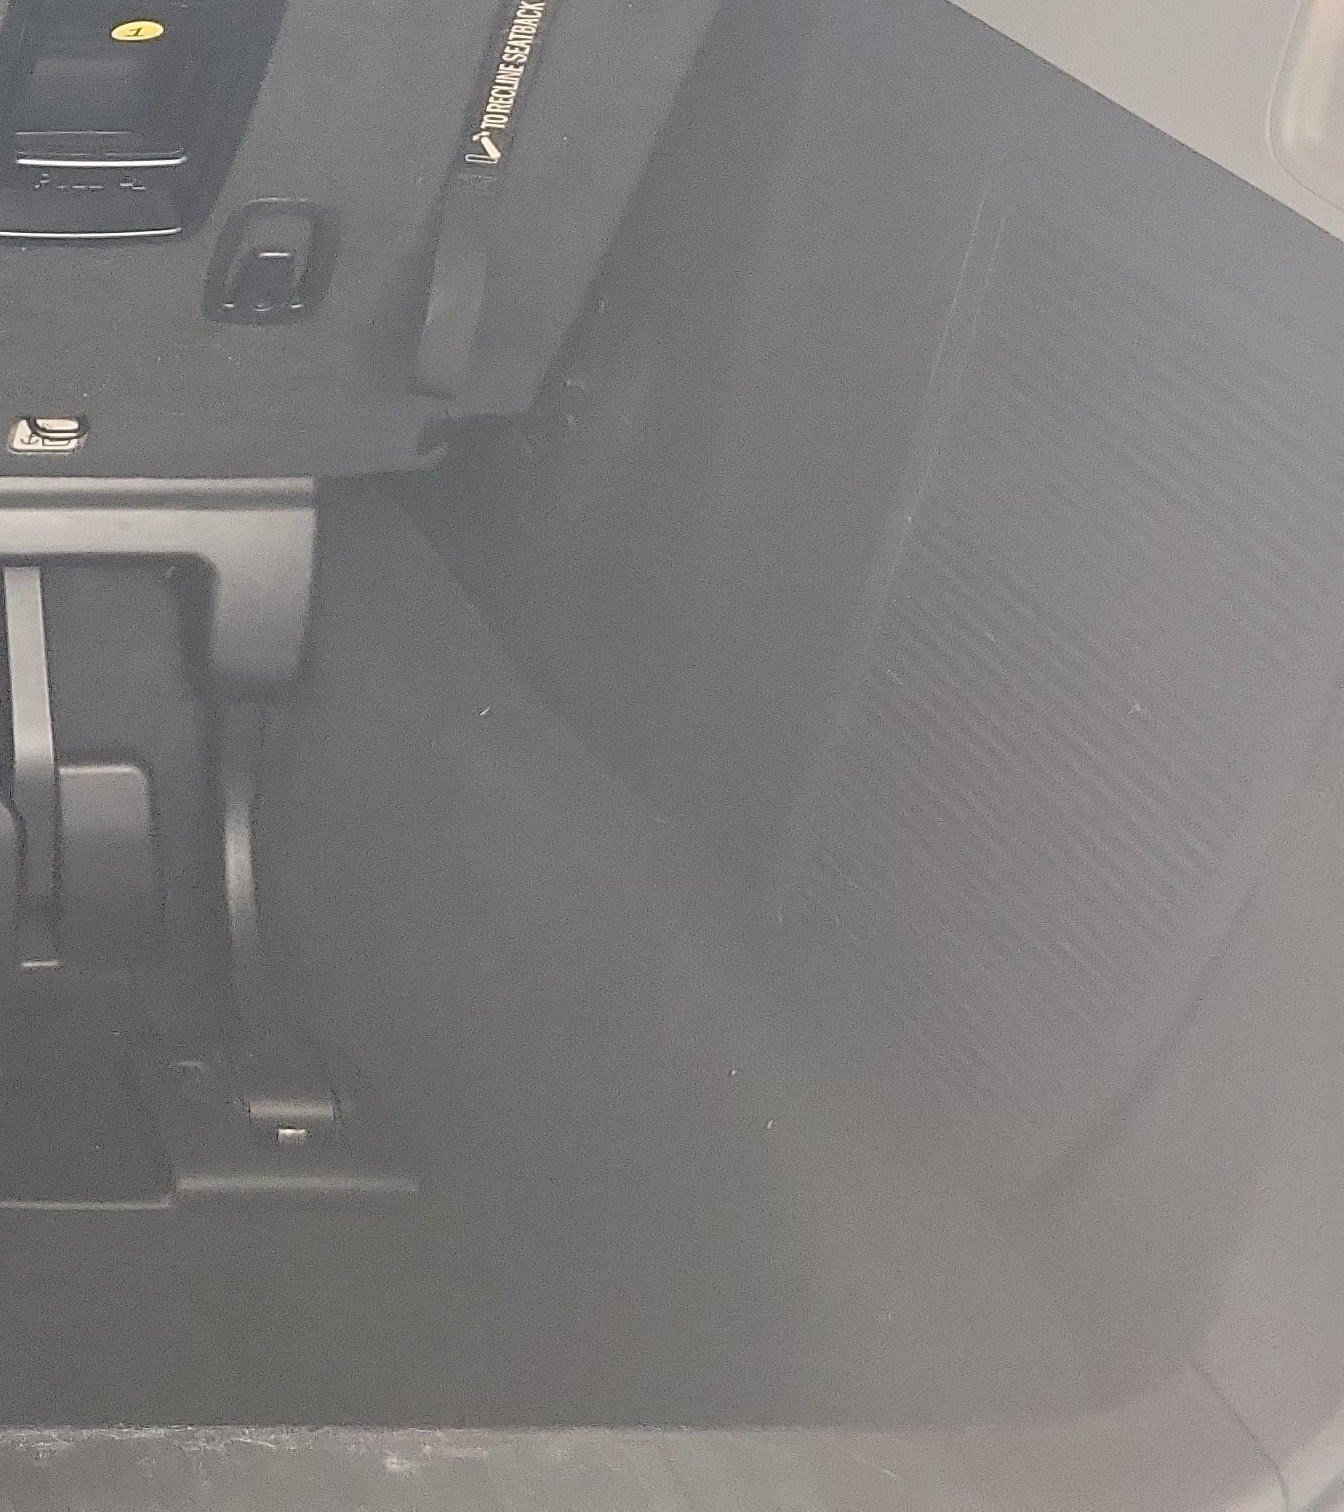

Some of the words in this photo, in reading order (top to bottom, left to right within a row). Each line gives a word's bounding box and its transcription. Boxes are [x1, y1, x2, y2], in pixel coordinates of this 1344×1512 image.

[501, 0, 547, 65] SEATBACK
[487, 62, 525, 116] RECLINE
[480, 111, 509, 130] TO
